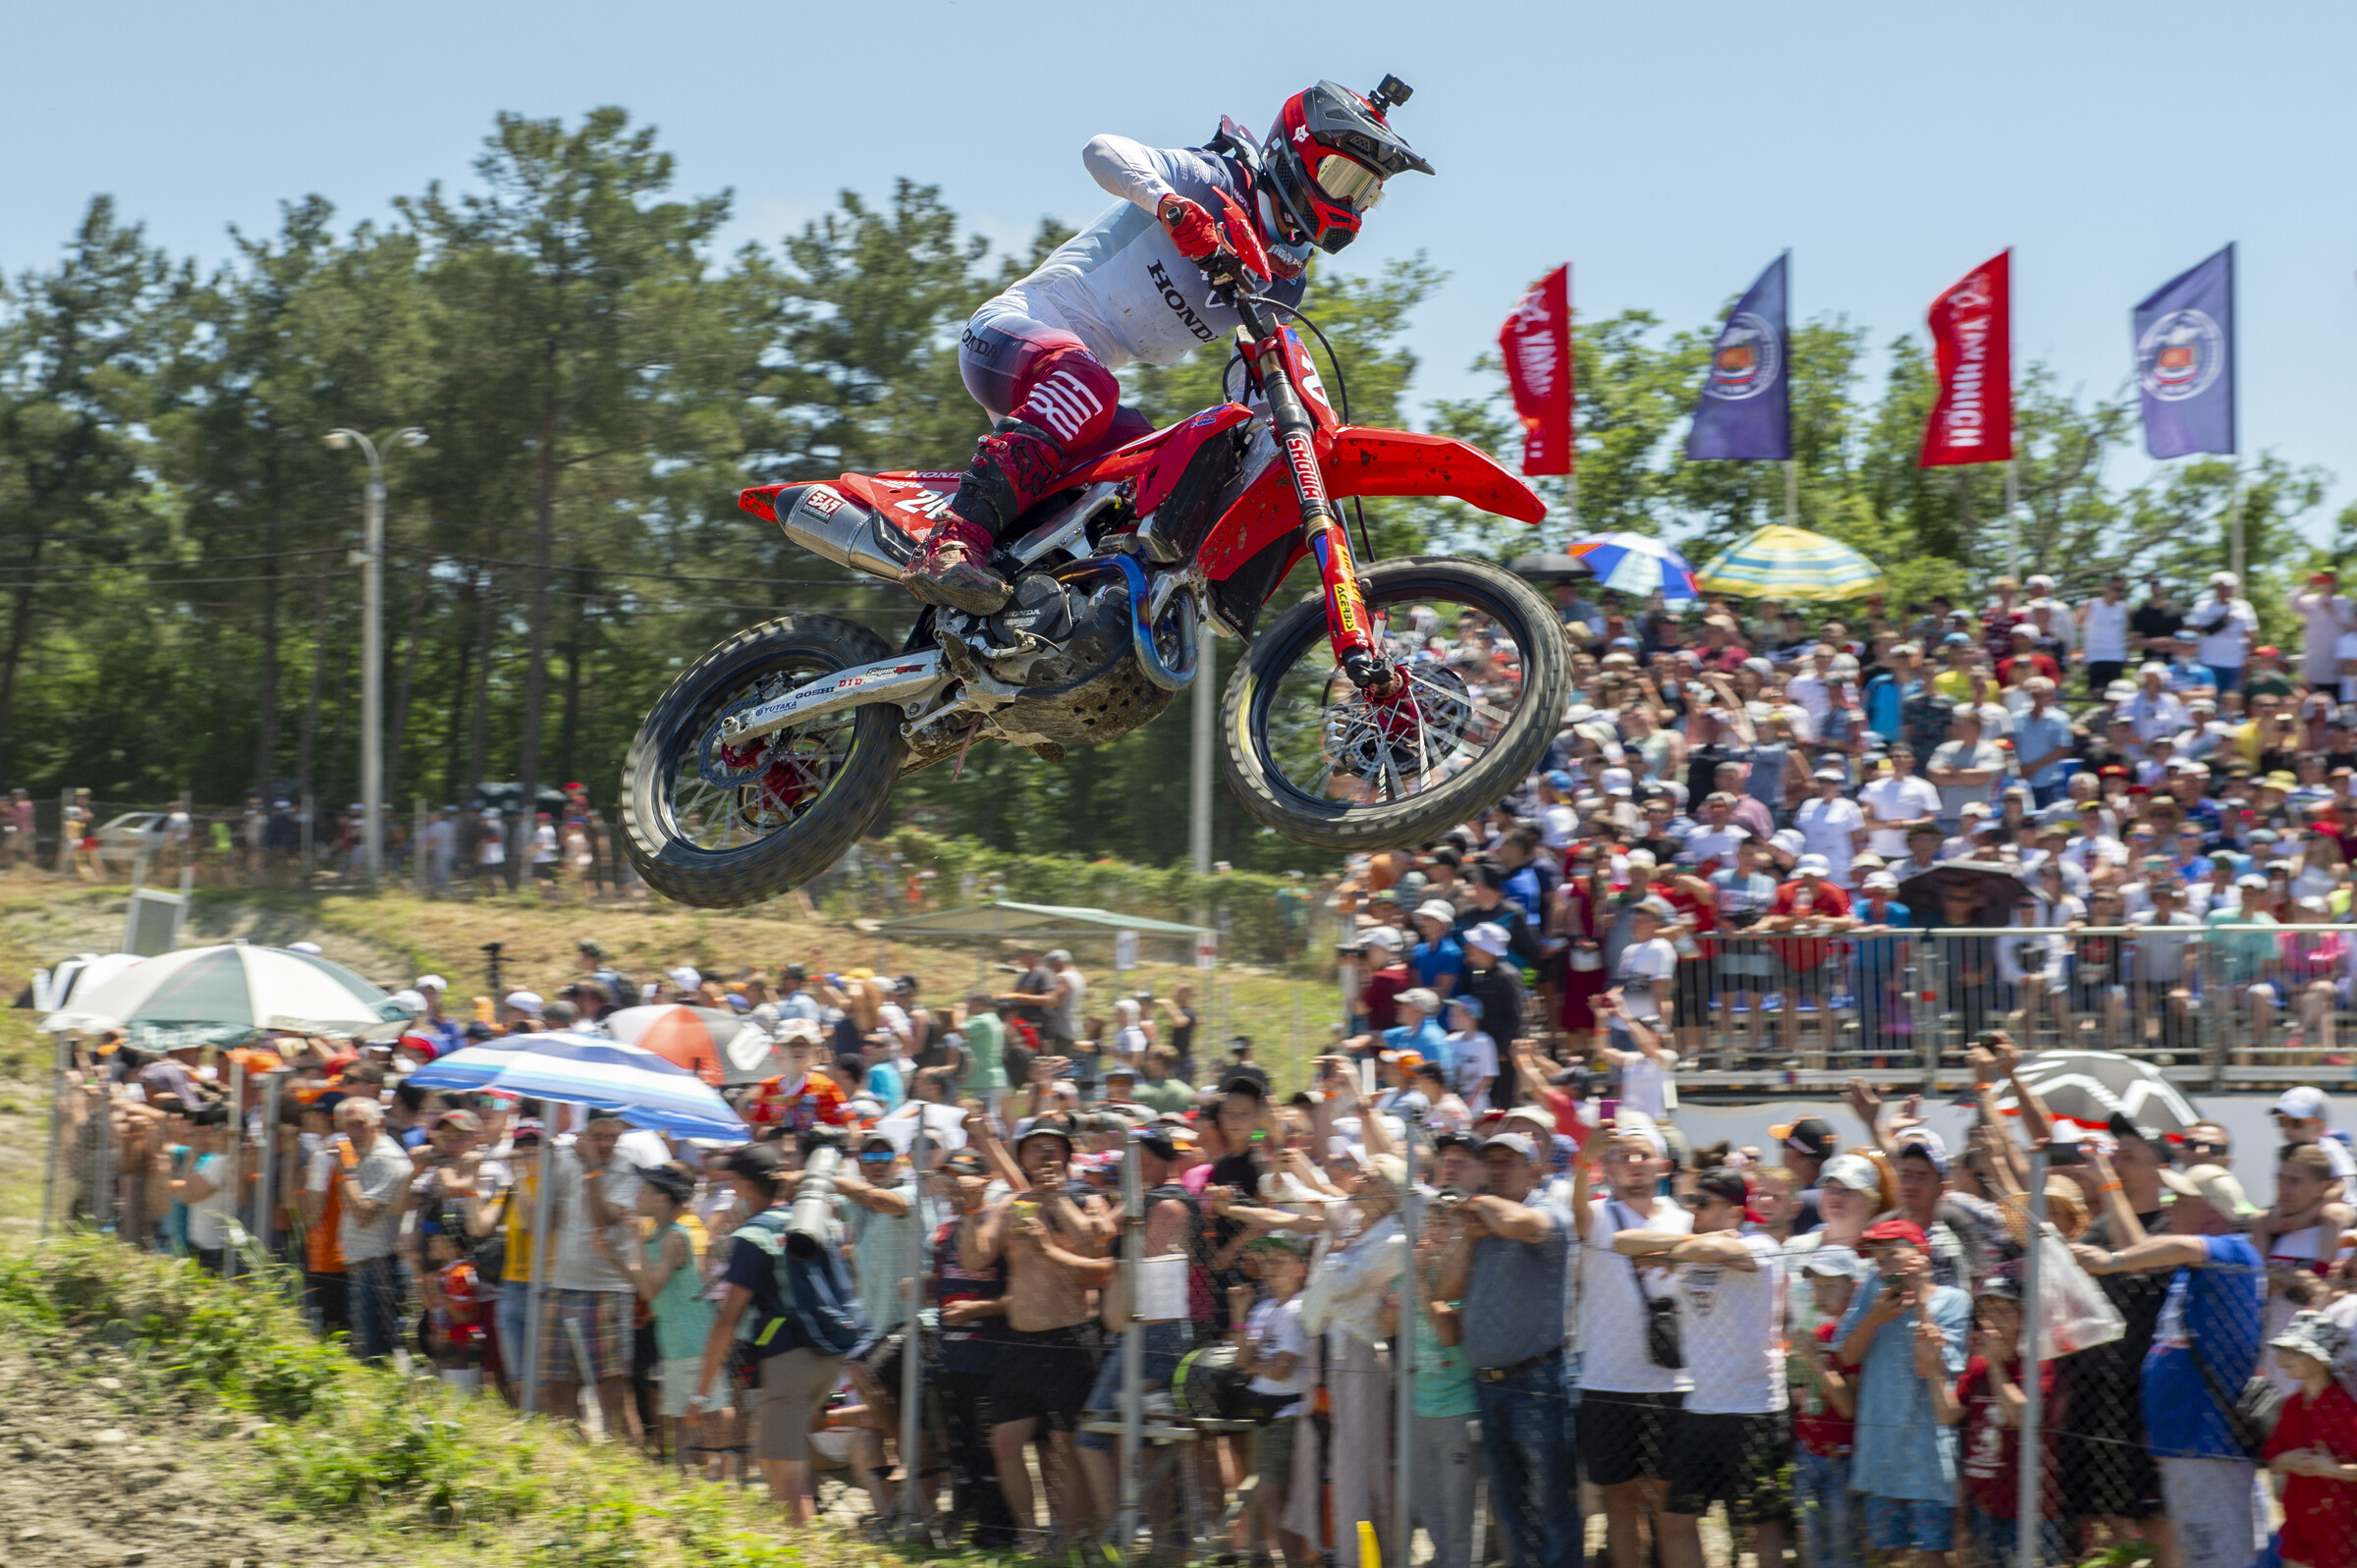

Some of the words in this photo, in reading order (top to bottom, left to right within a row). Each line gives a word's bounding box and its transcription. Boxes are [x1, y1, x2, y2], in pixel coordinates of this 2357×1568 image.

[1146, 258, 1219, 343] HOND
[960, 322, 999, 358] ONDA
[1286, 438, 1325, 501] SHOWA
[1003, 608, 1041, 618] HONDA
[839, 677, 863, 687] DID
[795, 686, 835, 699] GOSHI
[764, 700, 797, 715] YUTAKA
